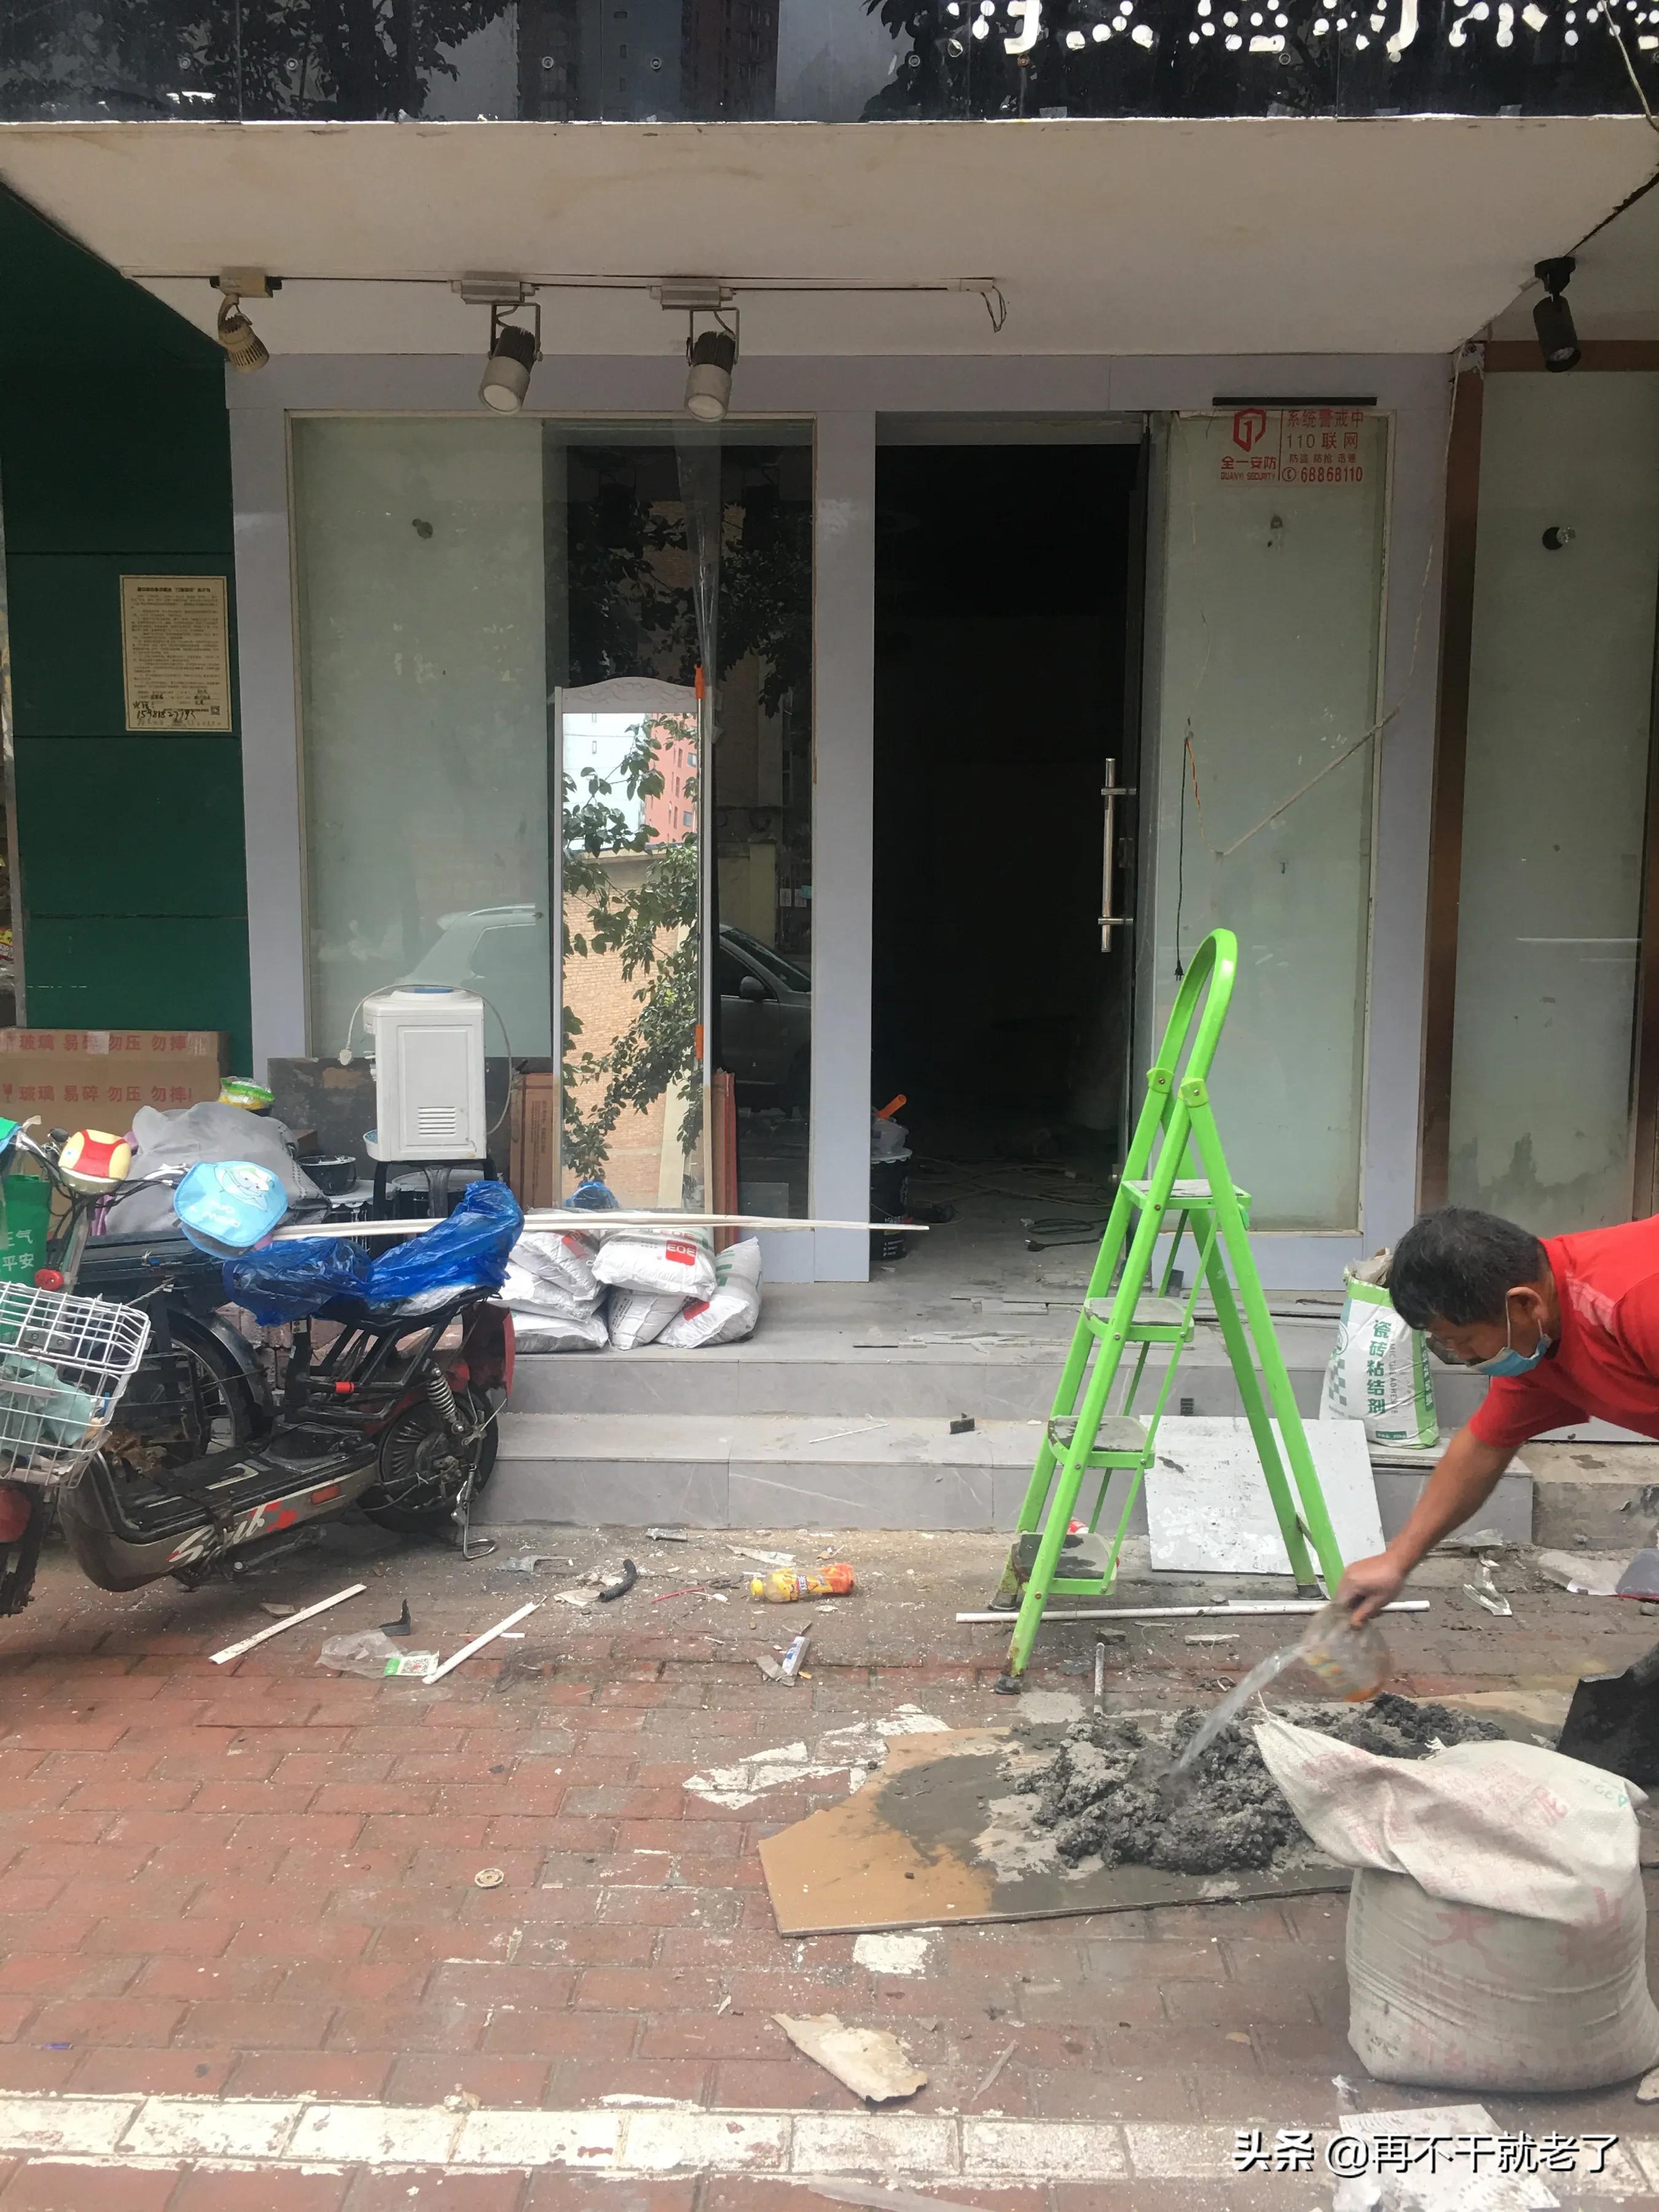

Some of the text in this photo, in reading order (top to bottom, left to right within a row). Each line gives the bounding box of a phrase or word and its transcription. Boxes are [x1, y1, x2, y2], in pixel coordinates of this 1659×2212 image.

[1287, 409, 1364, 428] 系统警戒中
[1221, 456, 1277, 470] 全一安防
[19, 1033, 54, 1051] 玻璃
[109, 1035, 141, 1051] 勿压
[19, 1084, 55, 1102] 玻璃
[63, 1085, 99, 1102] 易碎
[108, 1086, 142, 1102] 勿压
[2, 1252, 34, 1272] 平安
[1367, 1321, 1391, 1414] 瓷砖粘结剂
